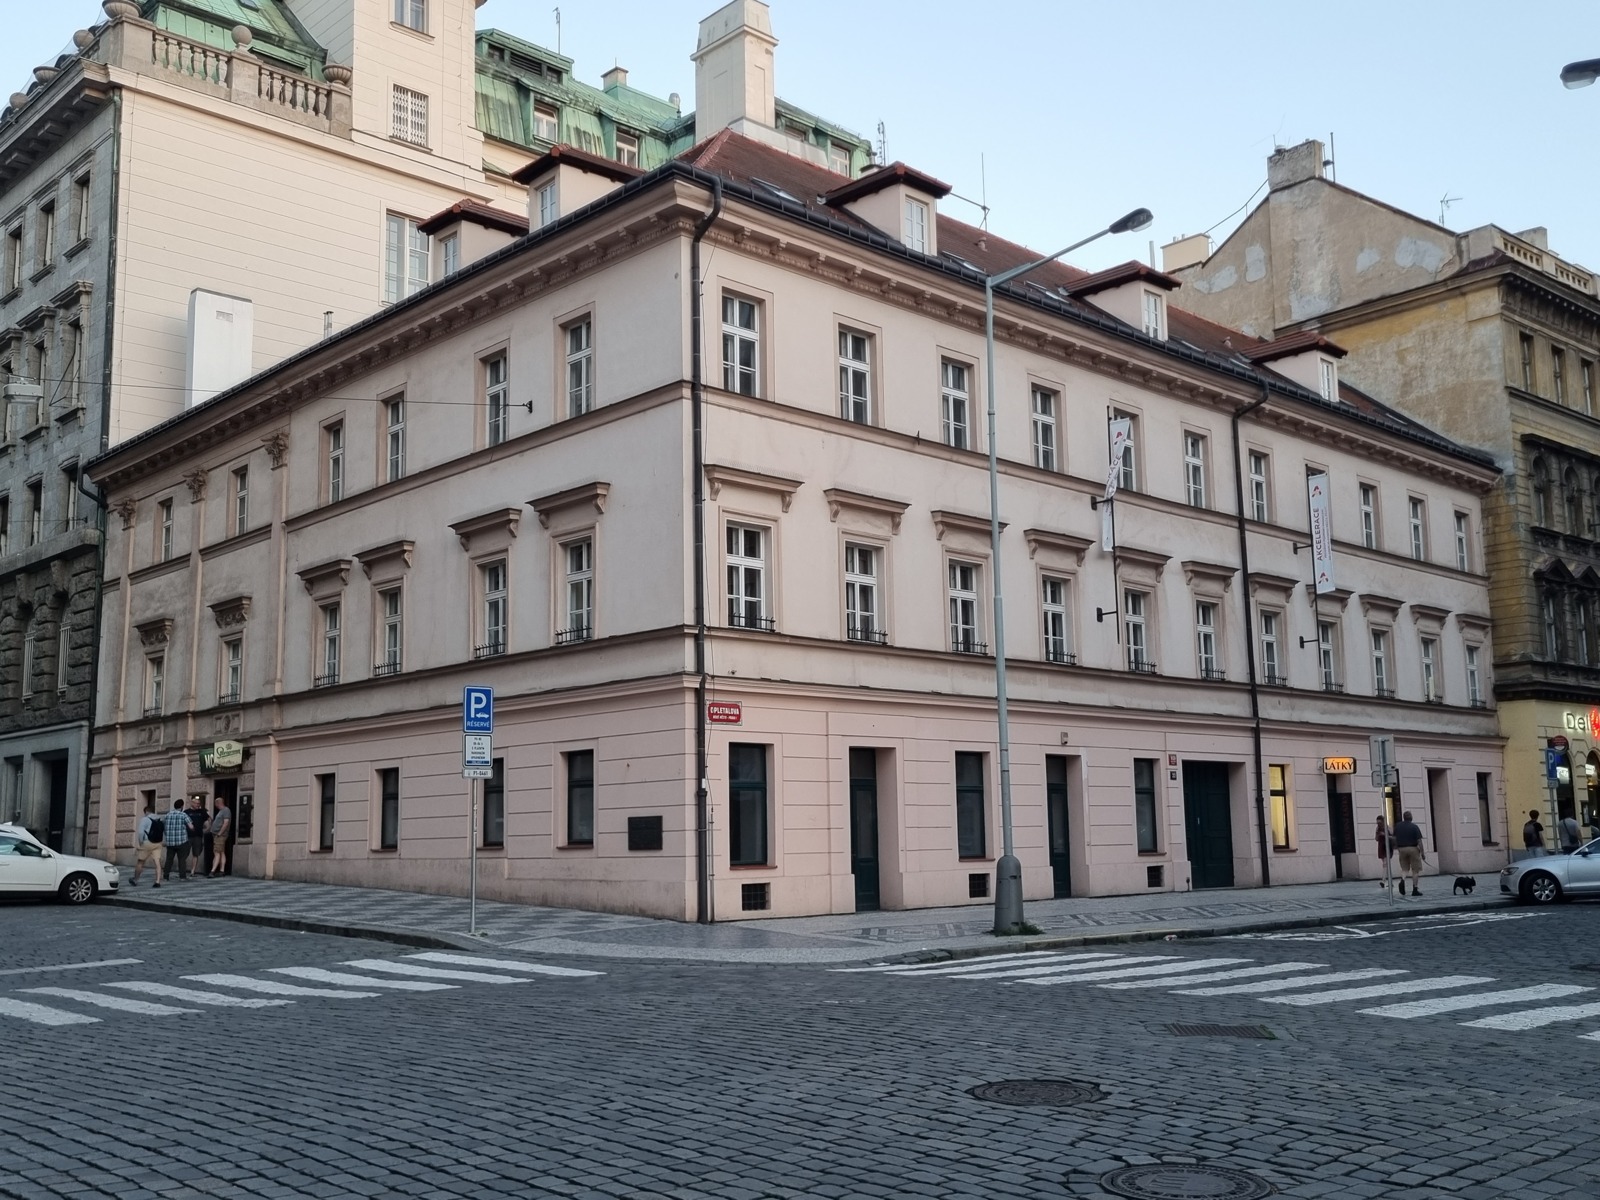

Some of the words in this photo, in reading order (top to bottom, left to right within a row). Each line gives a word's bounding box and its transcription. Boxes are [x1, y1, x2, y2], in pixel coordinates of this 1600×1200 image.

[1313, 507, 1323, 561] AKCELERACE
[470, 692, 486, 718] P
[710, 706, 739, 714] OPLETALOVA
[1325, 760, 1353, 770] LÁTKY
